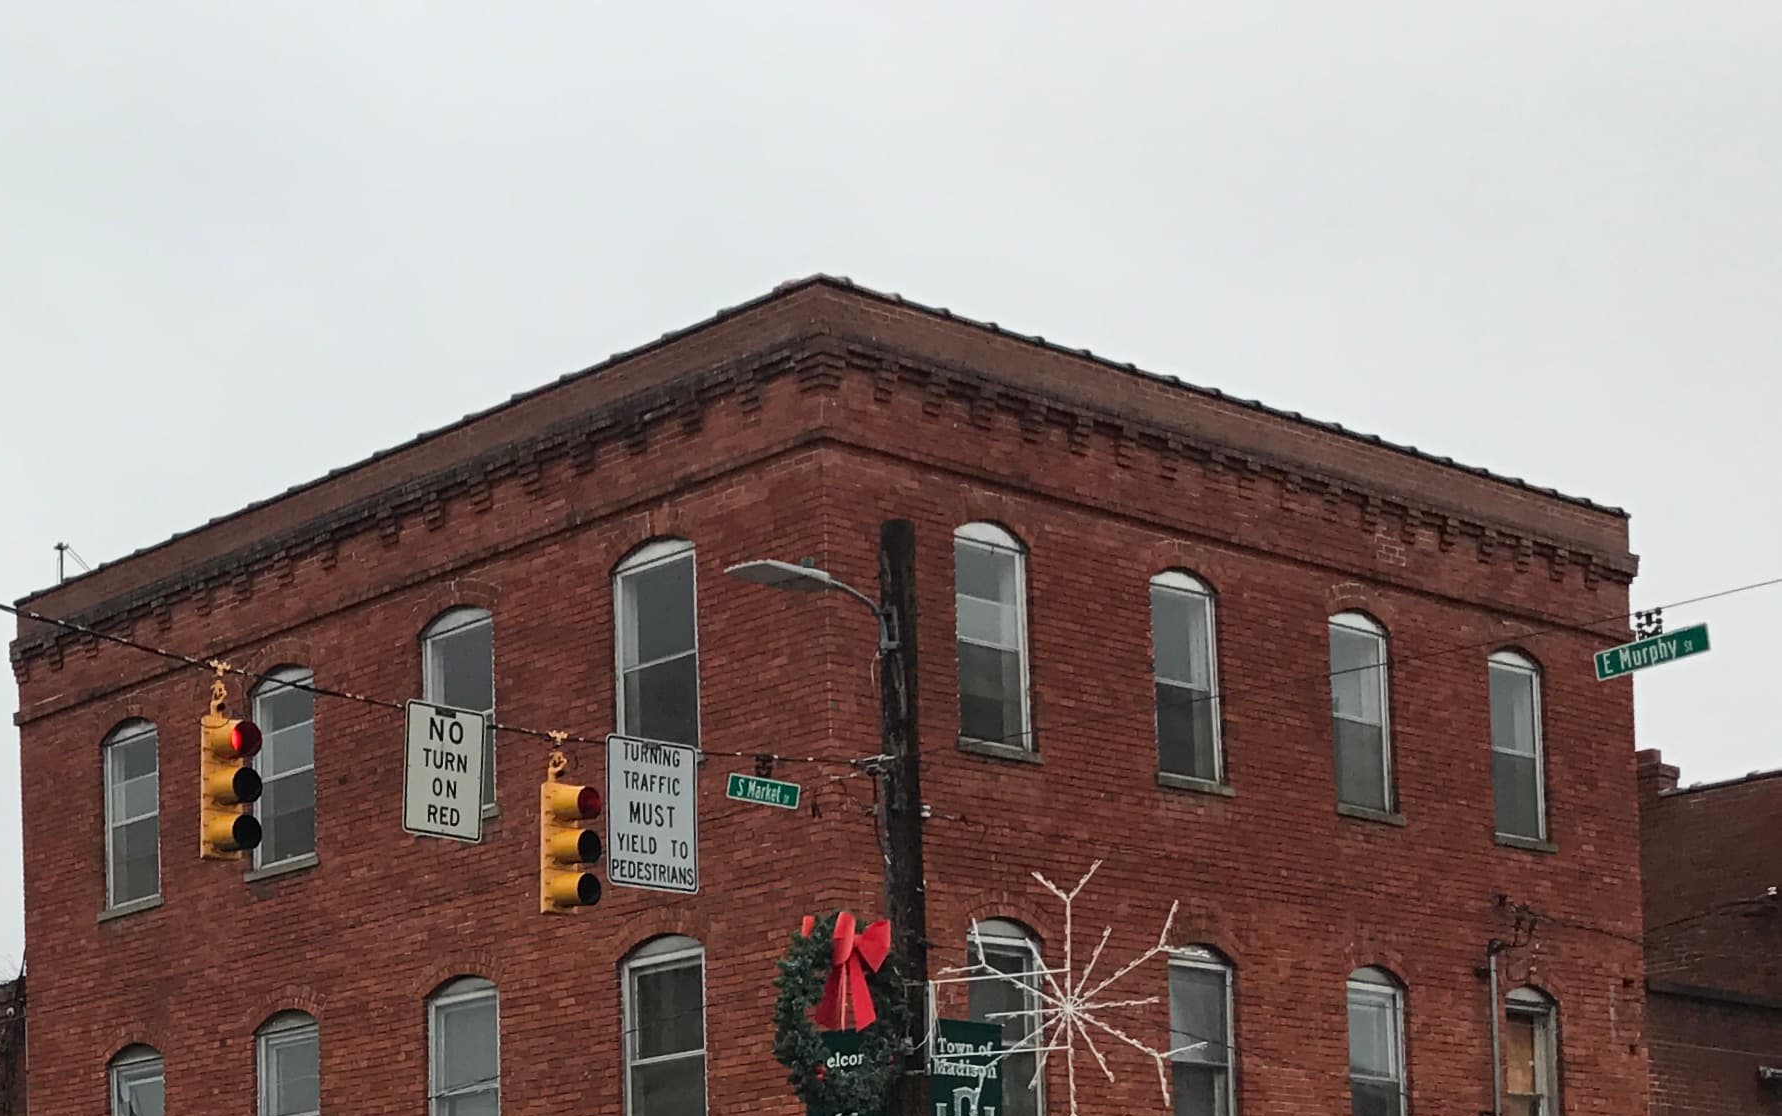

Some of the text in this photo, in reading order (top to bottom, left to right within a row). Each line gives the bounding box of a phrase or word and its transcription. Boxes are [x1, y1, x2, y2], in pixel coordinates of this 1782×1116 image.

[1603, 652, 1614, 675] E
[1619, 638, 1677, 671] Murphy
[429, 716, 464, 745] NO
[423, 747, 468, 774] TURN
[622, 741, 681, 768] TURNING
[432, 777, 458, 800] ON
[622, 770, 682, 797] TRAFFIC
[736, 779, 745, 798] S
[748, 781, 781, 803] Market
[427, 803, 461, 828] RED
[629, 800, 676, 829] MUST
[617, 832, 689, 861] YIELD TO
[611, 858, 695, 887] PEDESTRIANS
[937, 1037, 994, 1057] Town of
[933, 1057, 998, 1080] Madison
